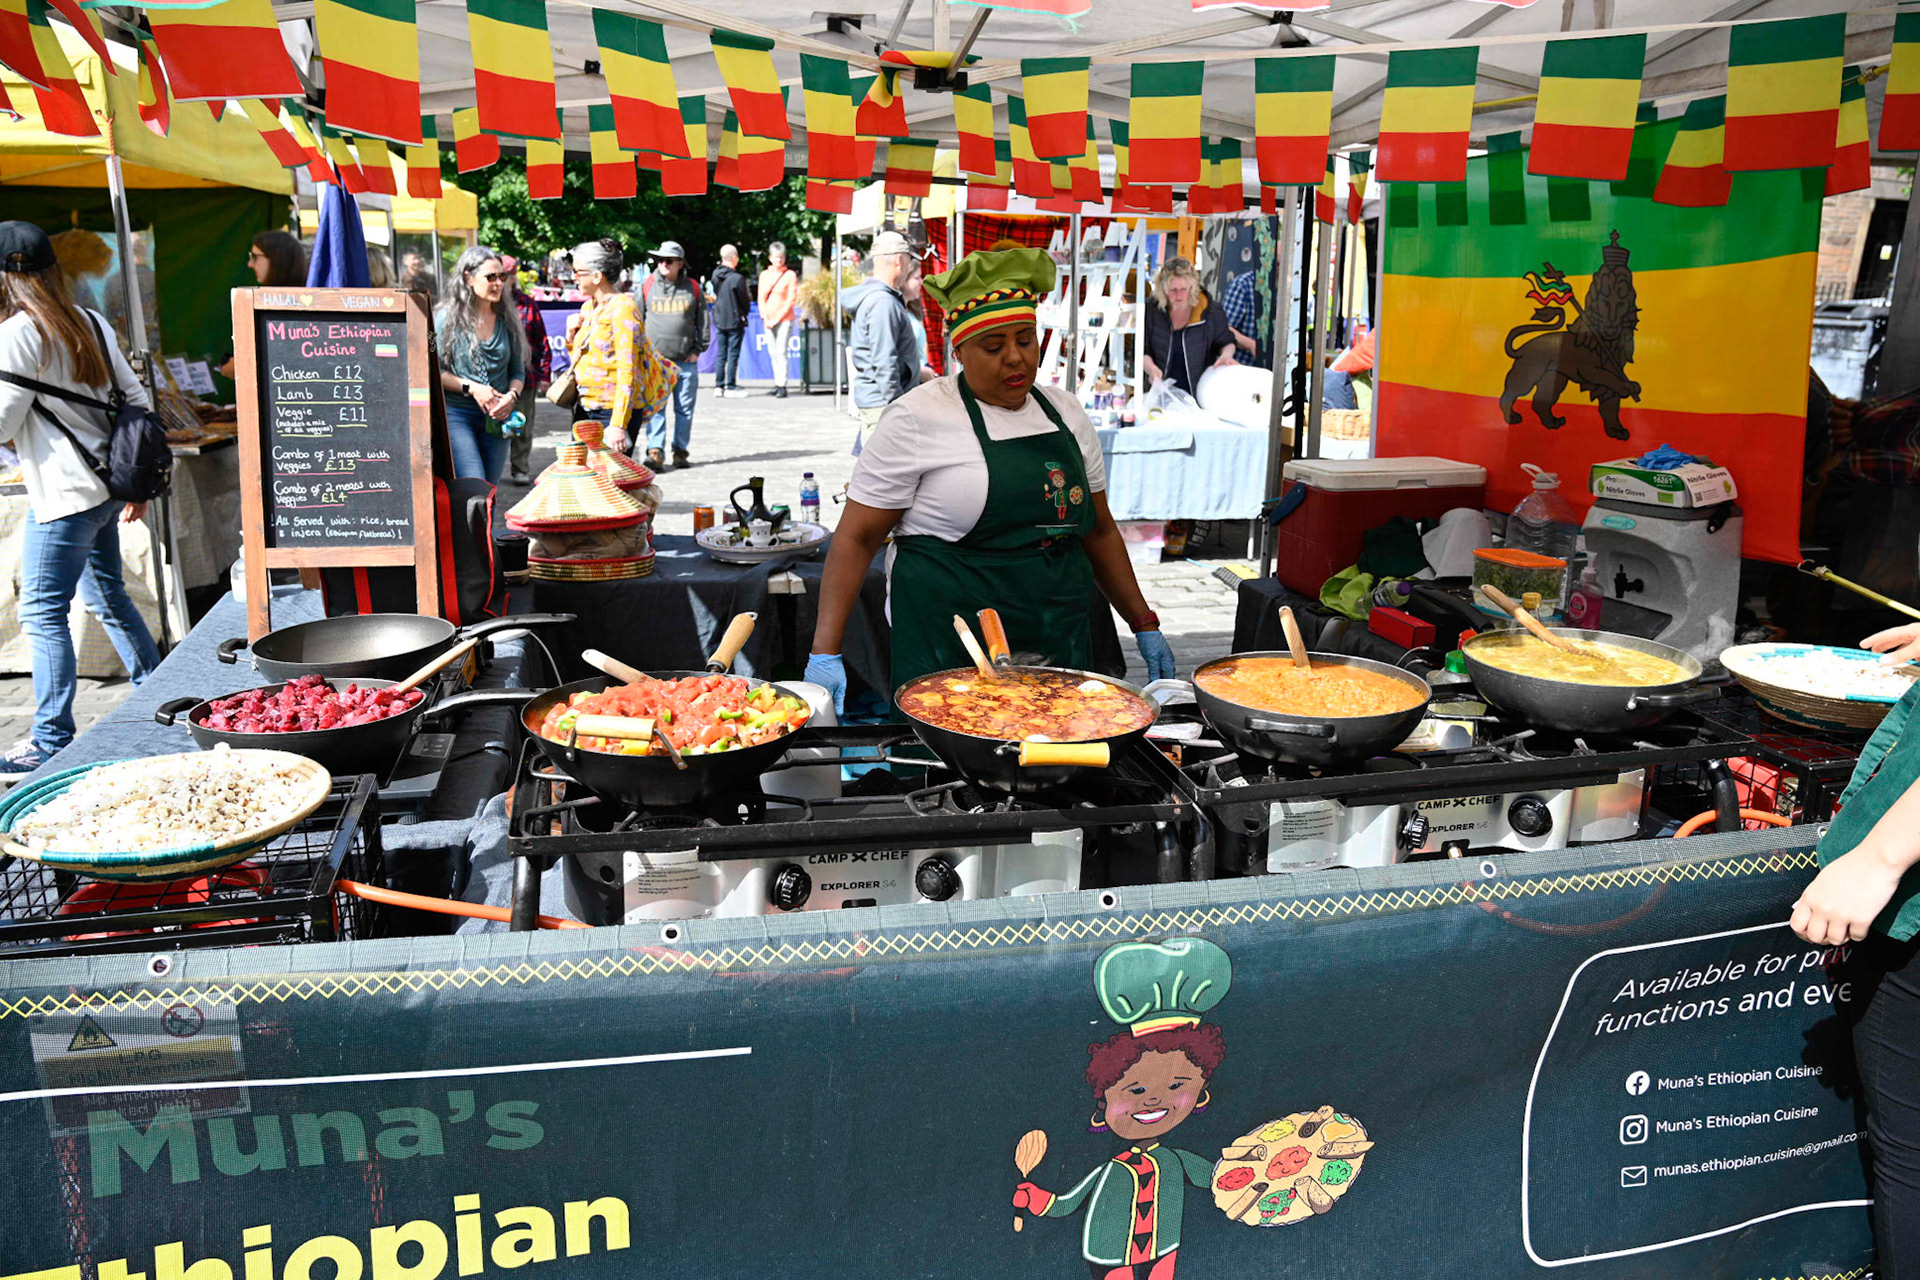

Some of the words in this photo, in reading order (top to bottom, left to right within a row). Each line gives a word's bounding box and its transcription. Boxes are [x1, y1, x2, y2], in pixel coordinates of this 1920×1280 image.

[262, 293, 301, 306] HALAL
[341, 296, 381, 308] VEGAN
[268, 322, 320, 340] Muna's
[328, 324, 391, 342] Ethiopian
[301, 341, 356, 358] Cuisine
[271, 364, 320, 380] Chicken
[334, 365, 362, 380] £12
[277, 386, 314, 400] Lamb
[333, 385, 363, 400] £13
[277, 406, 313, 420] Veggie
[339, 407, 367, 422] £11
[272, 445, 310, 460] Combo
[314, 450, 325, 462] of
[328, 449, 336, 459] 1
[337, 450, 361, 458] meat
[367, 449, 391, 459] with
[324, 460, 356, 472] £13
[1706, 470, 1728, 480] Gloves
[273, 481, 308, 495] Combo
[310, 484, 322, 496] of
[326, 483, 335, 492] 2
[335, 482, 364, 491] meats
[369, 481, 391, 489] with
[1624, 488, 1646, 497] Gloves
[322, 492, 348, 503] £14
[360, 516, 384, 525] rice,
[386, 517, 410, 526] bread
[291, 527, 322, 538] injera
[1417, 800, 1451, 810] CAMP
[1468, 795, 1502, 805] CHEF
[1428, 822, 1475, 834] EXPLORER
[808, 853, 849, 864] CAMP
[871, 850, 909, 860] CHEF
[820, 880, 880, 890] EXPLORER
[1611, 959, 1746, 1003] Available
[1753, 953, 1797, 976] for
[1594, 996, 1730, 1036] functions
[1737, 981, 1796, 1013] and
[1707, 1068, 1772, 1087] Ethiopian
[1775, 1064, 1823, 1079] Cuisine
[1706, 1111, 1770, 1130] Ethiopian
[1774, 1105, 1819, 1122] Cuisine
[1653, 1130, 1868, 1178] munas.ethiopian.cuisine@gmail.com
